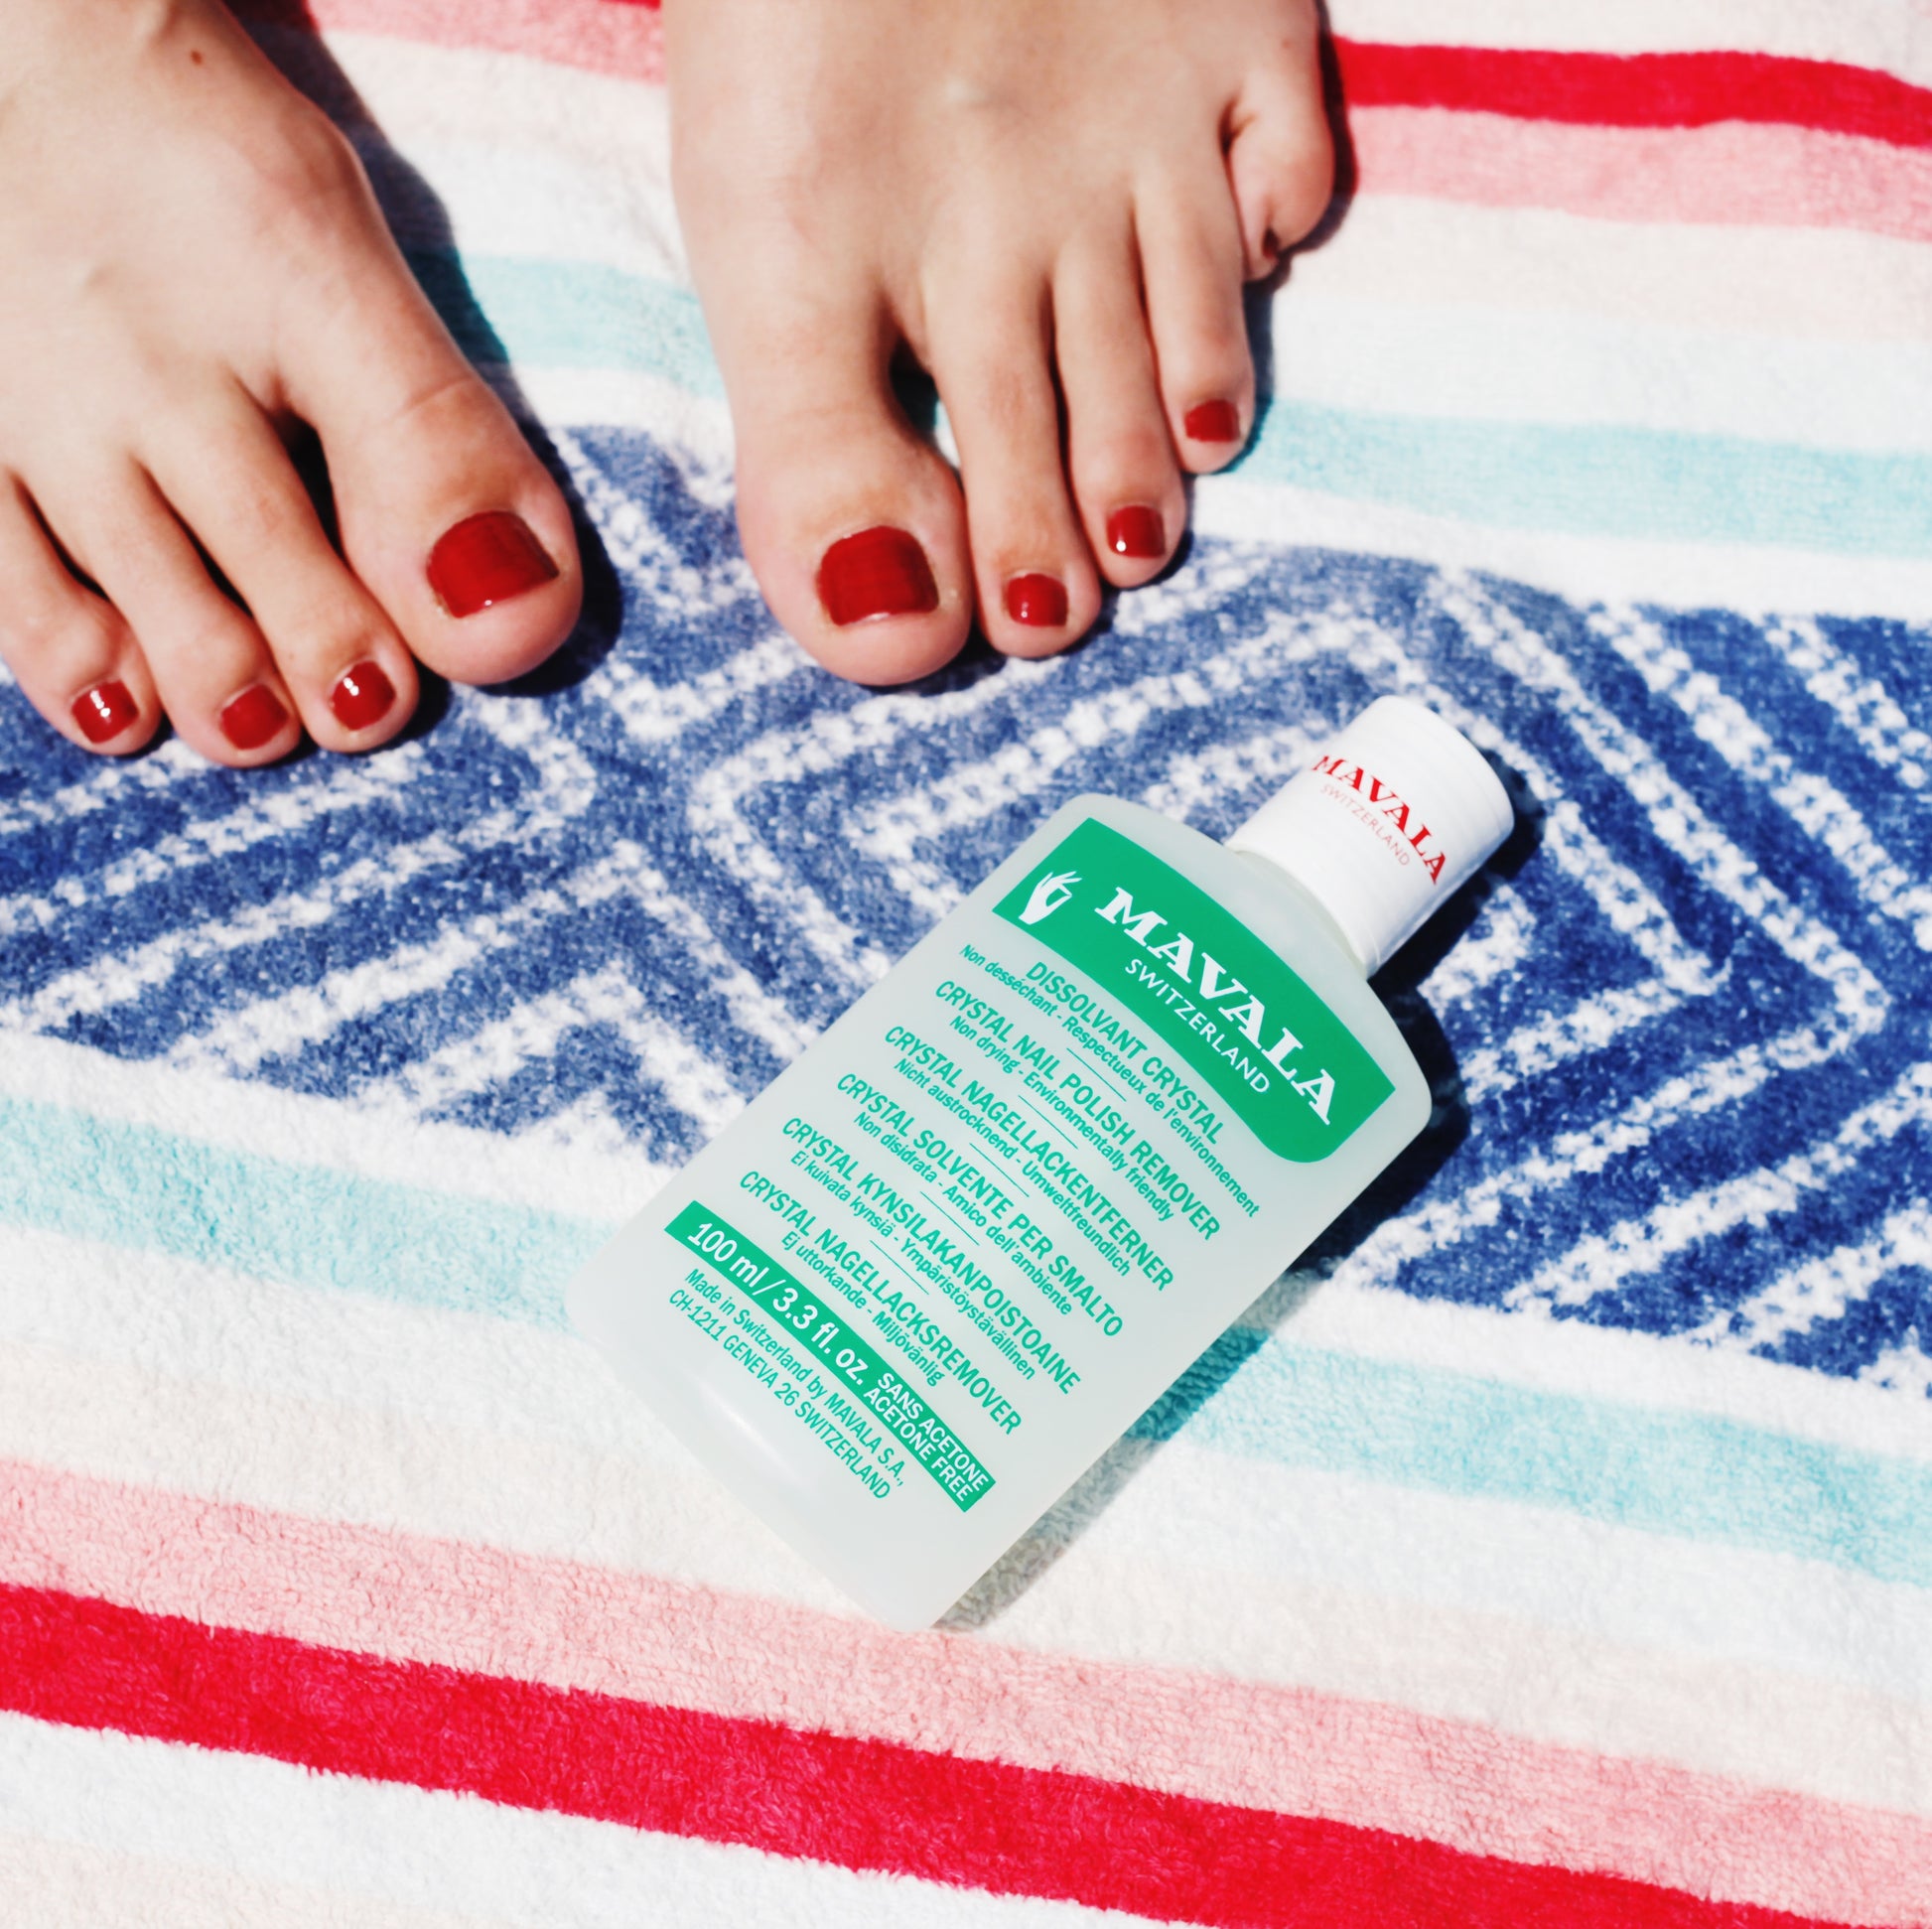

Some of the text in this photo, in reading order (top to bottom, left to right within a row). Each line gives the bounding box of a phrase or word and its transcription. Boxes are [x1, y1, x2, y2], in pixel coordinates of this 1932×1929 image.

[1311, 756, 1447, 886] MAVALA
[1320, 784, 1410, 866] SWITZERLAND
[936, 980, 1221, 1240] CRYSTAL NAIL POLISH REMOVER
[960, 944, 986, 966] Non
[985, 961, 1057, 1017] desséchant
[1061, 1016, 1147, 1094] Respectueux
[1145, 1090, 1165, 1112] de
[1163, 1107, 1260, 1217] l'environnement
[1026, 961, 1224, 1144] DISSOLVANT CRYSTAL
[1094, 887, 1335, 1126] MAVALA
[1125, 959, 1270, 1093] SWITZERLAND
[837, 1073, 1124, 1336] CRYSTAL SOLVENTE PER SMALTO
[854, 1112, 882, 1138] Non
[880, 1132, 938, 1183] disidrata
[942, 1184, 987, 1227] Amico
[986, 1225, 1073, 1315] dell'ambiente
[885, 1026, 1173, 1291] CRYSTAL NAGELLACKENTFERNER
[894, 1058, 930, 1089] Nicht
[927, 1085, 1019, 1160] austrocknend
[1022, 1161, 1132, 1277] Umweltfreundlich
[950, 1016, 977, 1039] Non
[976, 1035, 1021, 1074] drying
[1024, 1071, 1128, 1171] Environmentally
[1125, 1168, 1174, 1222] friendly
[687, 1222, 738, 1263] 100
[810, 1322, 840, 1354] fl.
[835, 1350, 870, 1386] oz.
[740, 1171, 1023, 1435] CRYSTAL NAGELLACKSREMOVER
[781, 1231, 799, 1254] Ej
[795, 1245, 867, 1309] uttorkande
[872, 1310, 946, 1387] Miljövänlig
[782, 1118, 1081, 1391] CRYSTAL KYNSILAKANPOISTOAINE
[790, 1151, 807, 1168] Ei
[805, 1160, 852, 1202] kuivata
[849, 1193, 895, 1237] kynsiä
[897, 1238, 1036, 1380] Ympäristöystävällinen
[669, 1289, 891, 1500] CH-1211 GENEVA 26 SWITZERLAND
[685, 1268, 905, 1487] Made in Switzerland by MAVALA S.A.,
[864, 1388, 973, 1502] ACETONE FREE
[878, 1372, 989, 1490] SANS ACETONE
